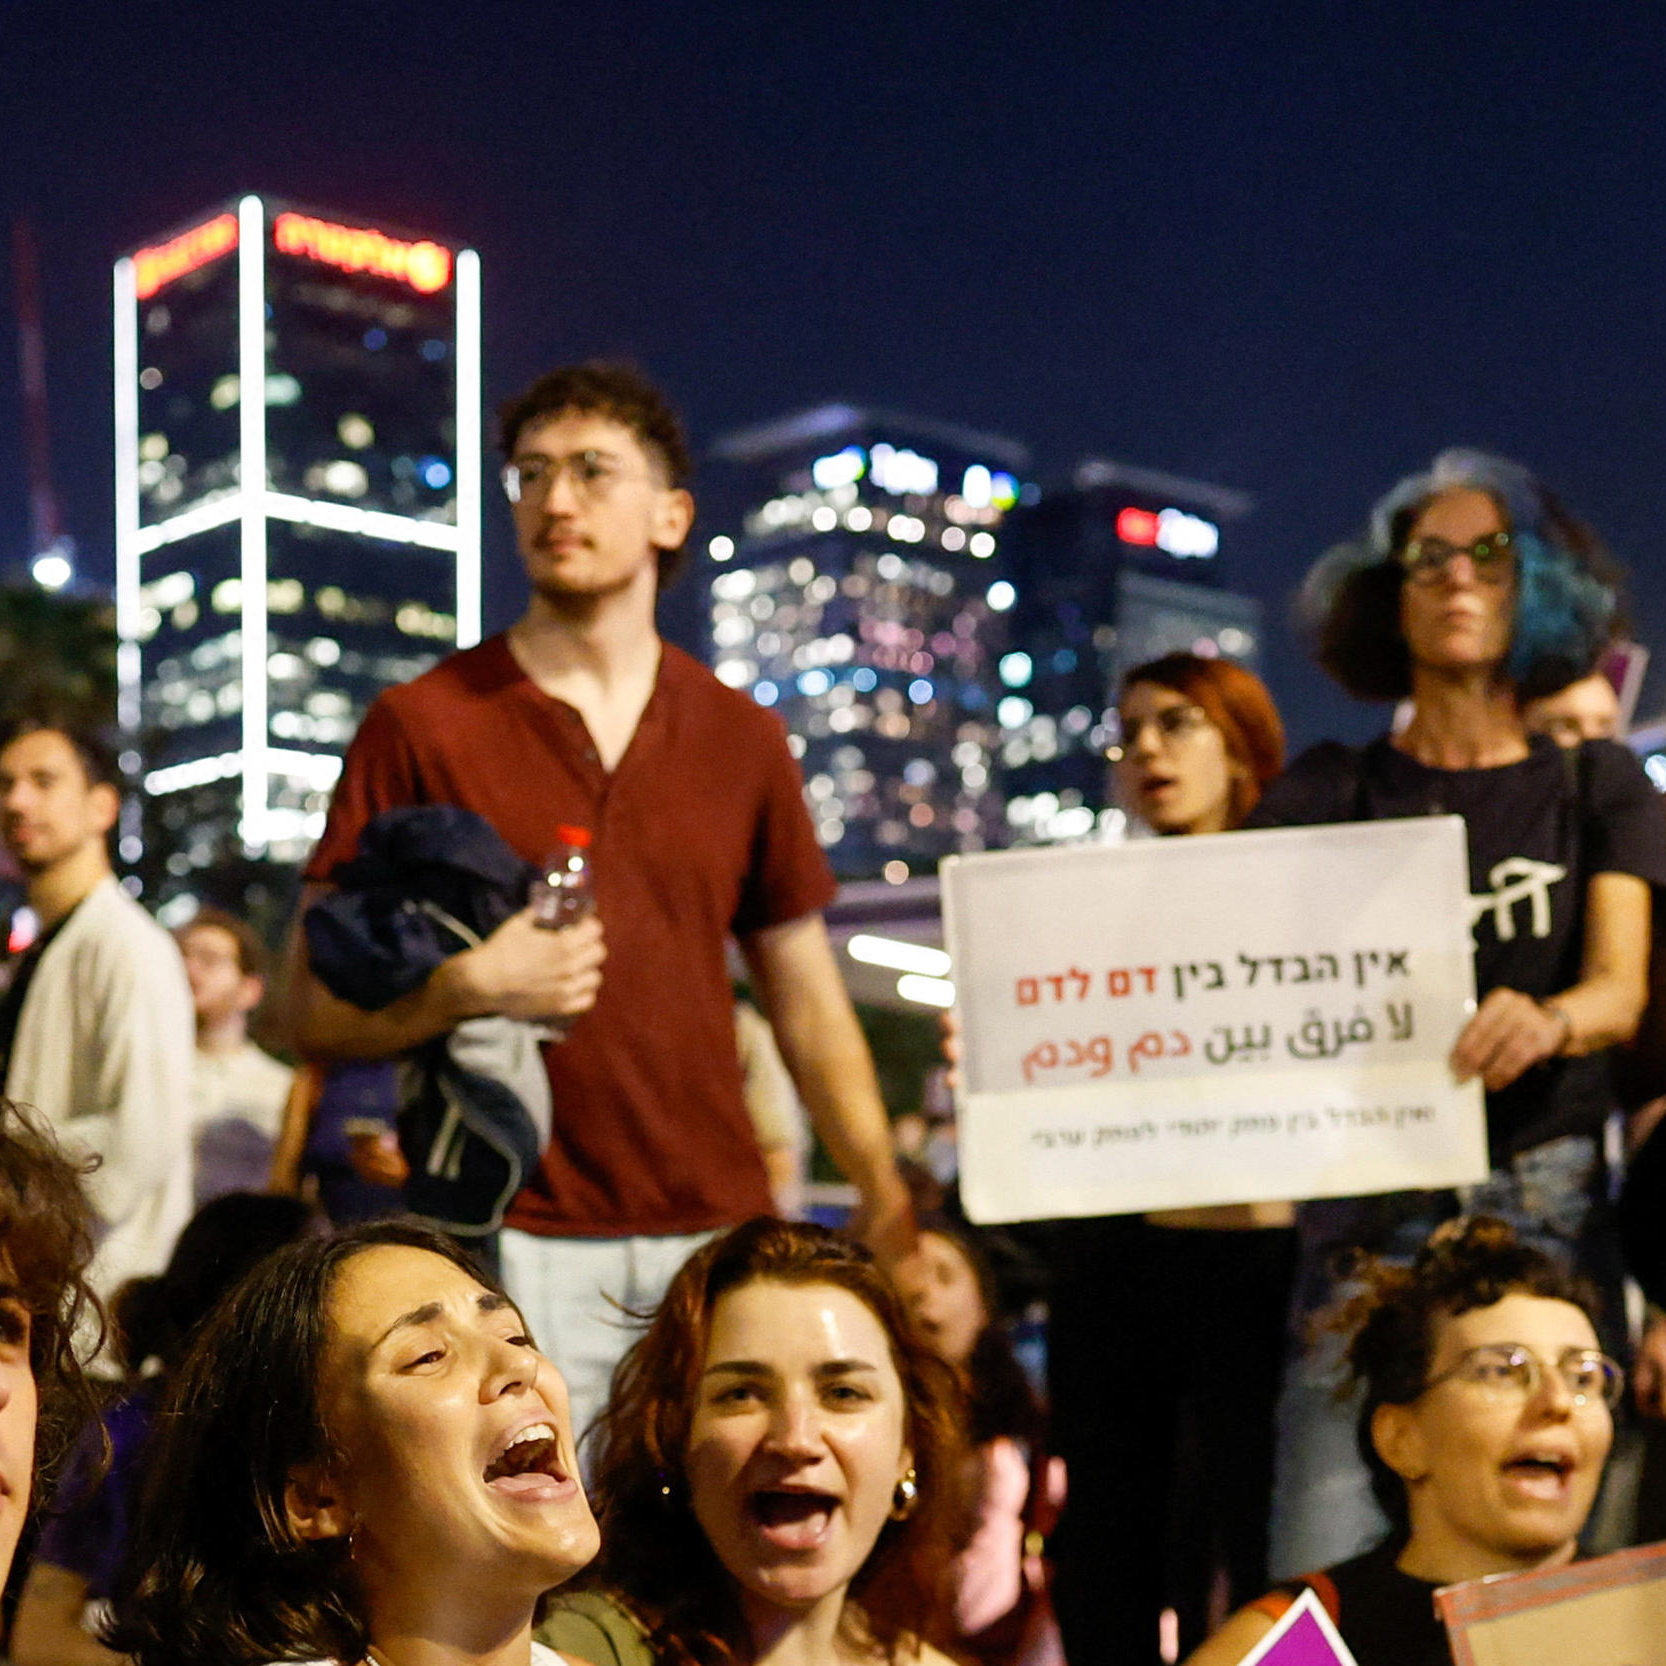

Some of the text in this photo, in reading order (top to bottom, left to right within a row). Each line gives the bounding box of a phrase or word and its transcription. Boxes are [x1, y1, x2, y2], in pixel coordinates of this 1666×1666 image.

[1015, 950, 1410, 1006] אין הבדל בין דם לדם
[1022, 1002, 1414, 1082] لا فرق بين دم ودم
